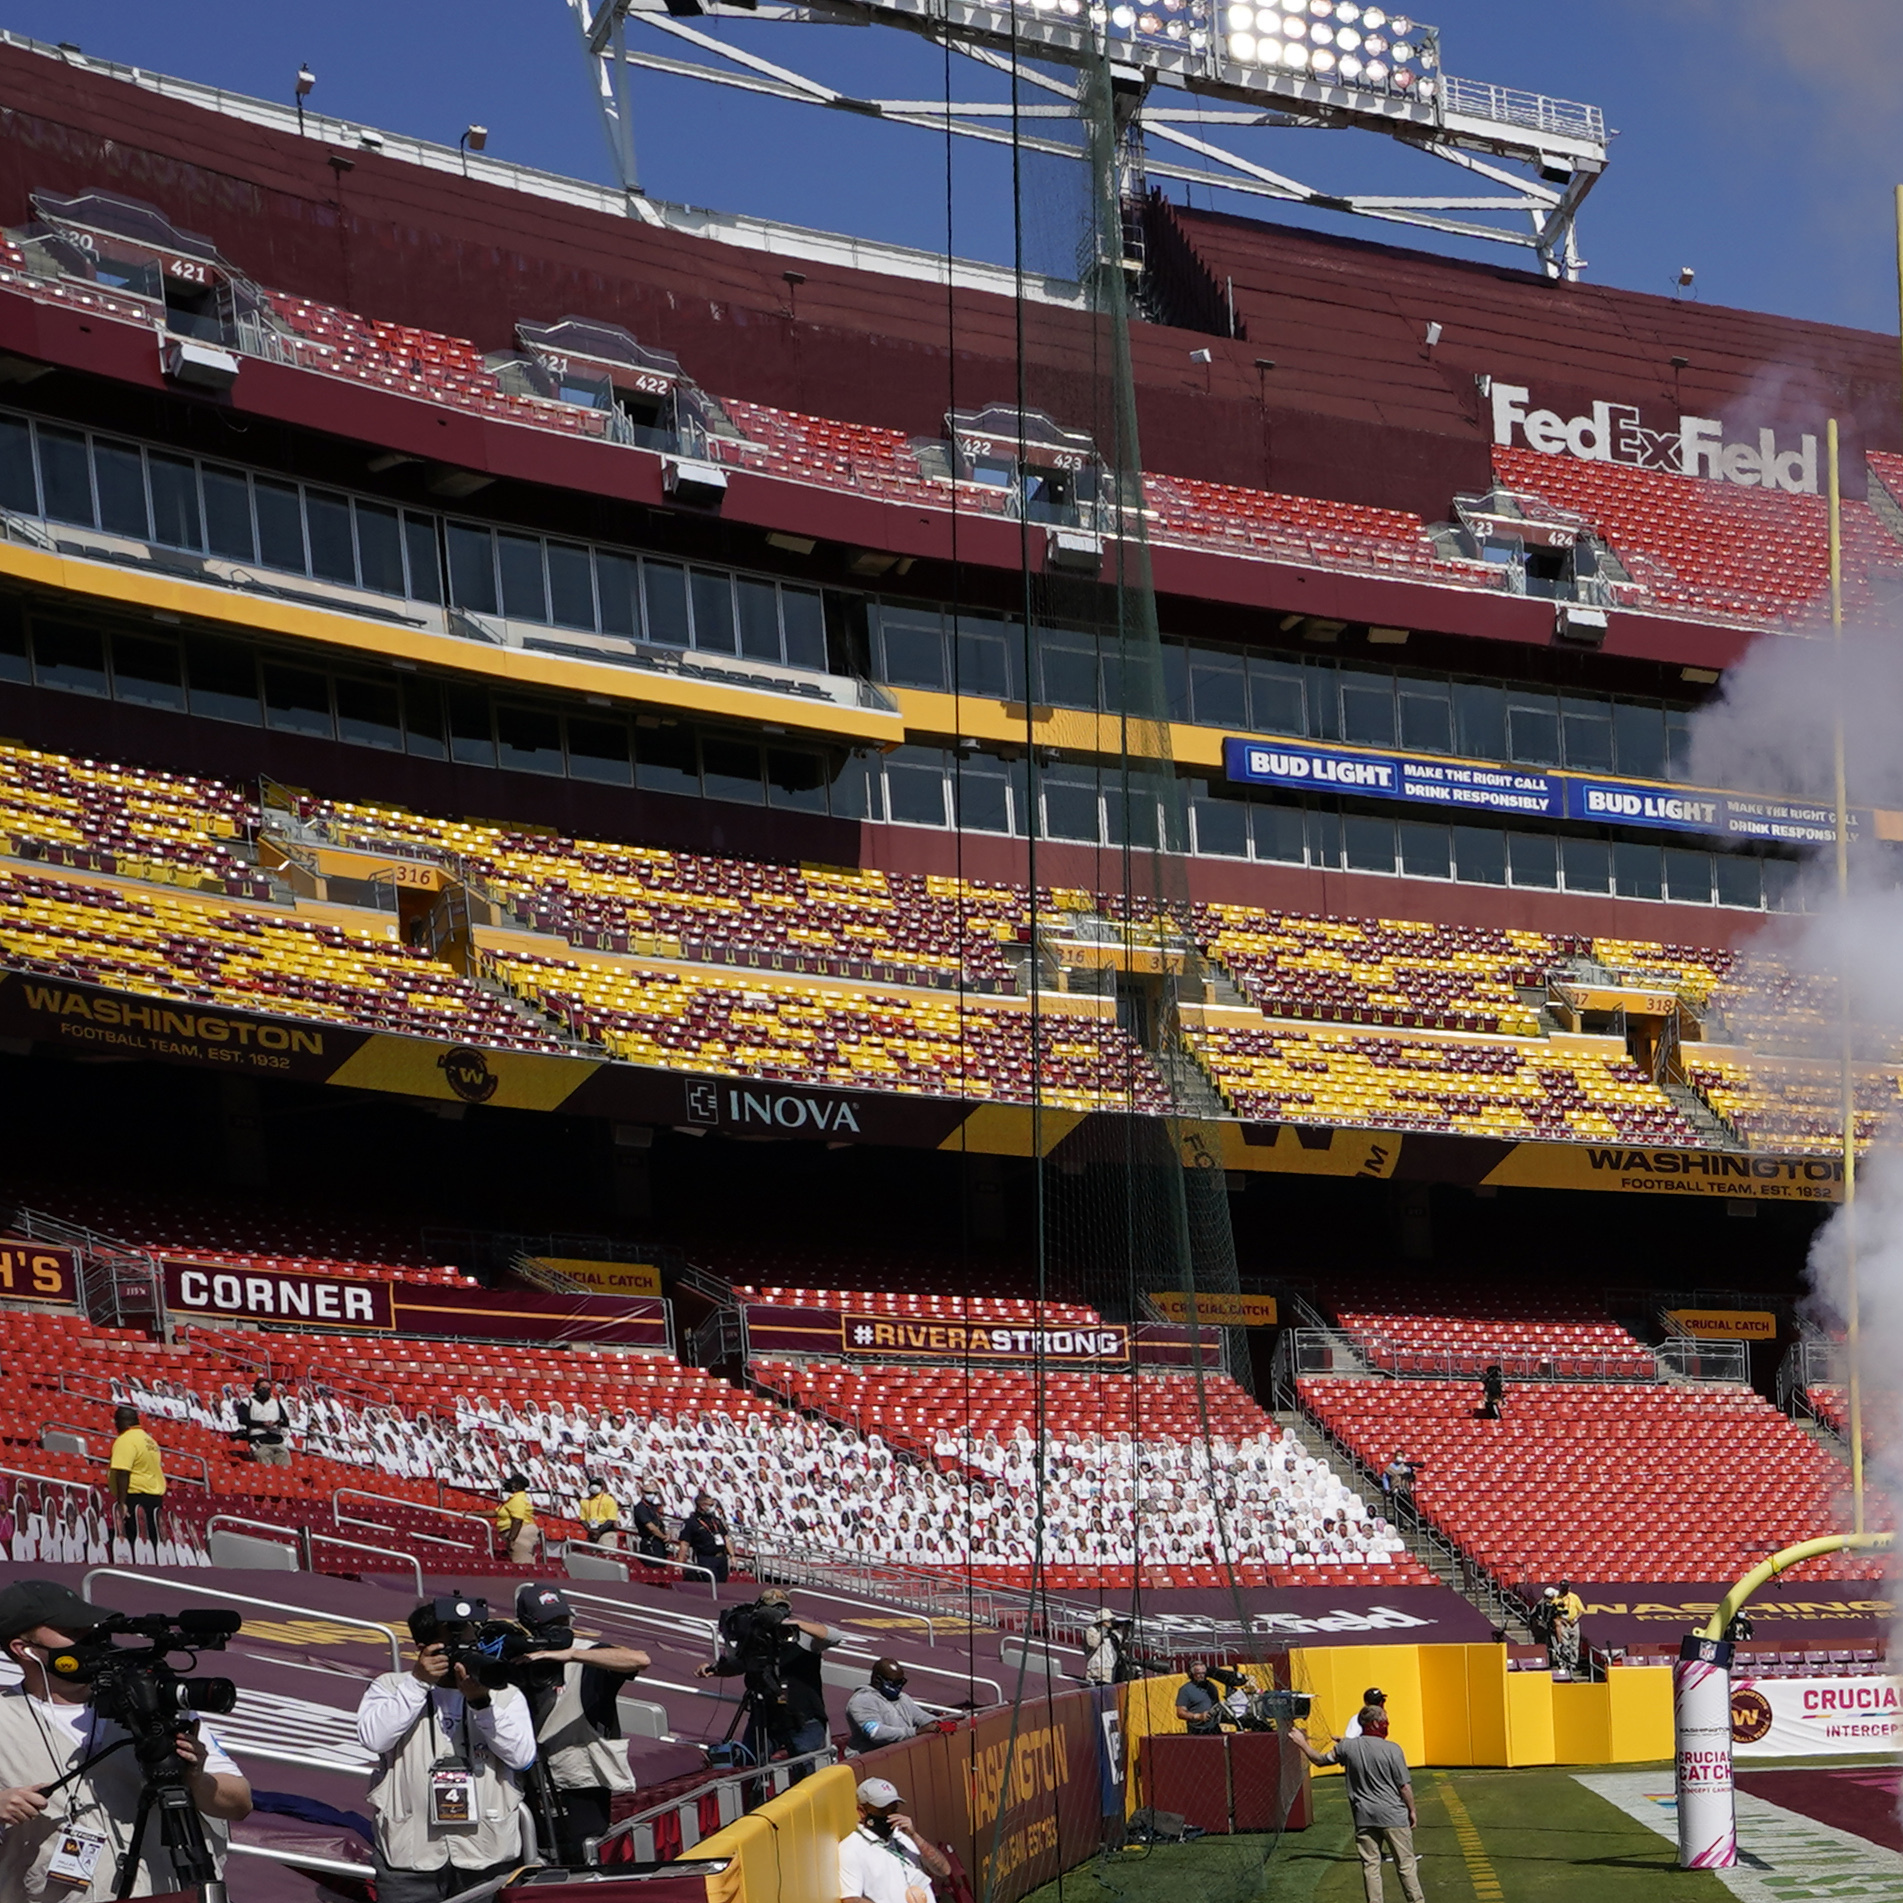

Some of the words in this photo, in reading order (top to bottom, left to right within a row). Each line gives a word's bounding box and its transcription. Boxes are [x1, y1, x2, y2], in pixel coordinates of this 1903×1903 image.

[171, 260, 205, 282] 421
[637, 375, 668, 394] 422
[963, 440, 991, 456] 422
[1491, 382, 1817, 494] FedExField
[1053, 454, 1082, 471] 423
[1548, 531, 1573, 547] 424
[1251, 751, 1310, 777] BUD
[1313, 757, 1392, 785] LIGHT
[1404, 763, 1443, 779] MAKE
[1446, 768, 1471, 783] THE
[1474, 771, 1511, 787] RIGHT
[1515, 775, 1547, 790] CALL
[1405, 783, 1450, 800] DRINK
[1453, 788, 1549, 811] RESPONSIBLY
[1588, 790, 1642, 811] BUD
[1644, 797, 1717, 823] LIGHT
[1727, 800, 1763, 814] MAKE
[1766, 805, 1788, 817] THE
[1790, 807, 1826, 822] RIGHT
[1729, 819, 1769, 833] DRINK
[397, 867, 430, 886] 316
[1646, 998, 1672, 1014] 318
[23, 984, 323, 1055] WASHINGTON
[61, 1022, 146, 1049] FOOTBALL
[148, 1039, 203, 1060] TEAM,
[208, 1046, 244, 1064] EST.
[249, 1051, 290, 1069] 1932
[460, 1068, 483, 1086] W
[730, 1089, 860, 1133] INOVA
[1621, 1178, 1703, 1193] FOOTBALL
[1716, 1182, 1756, 1196] TEAM,
[1760, 1183, 1791, 1197] EST.
[1795, 1187, 1831, 1199] 1932
[609, 1274, 653, 1289] CATCH
[181, 1270, 374, 1321] CORNER
[1230, 1304, 1270, 1317] CATCH
[1684, 1319, 1732, 1331] CRUCIAL
[1735, 1321, 1770, 1332] CATCH
[854, 1323, 1118, 1354] #RIVERASTRONG
[1732, 1709, 1759, 1726] W
[962, 1723, 1069, 1837] WASHINGTON
